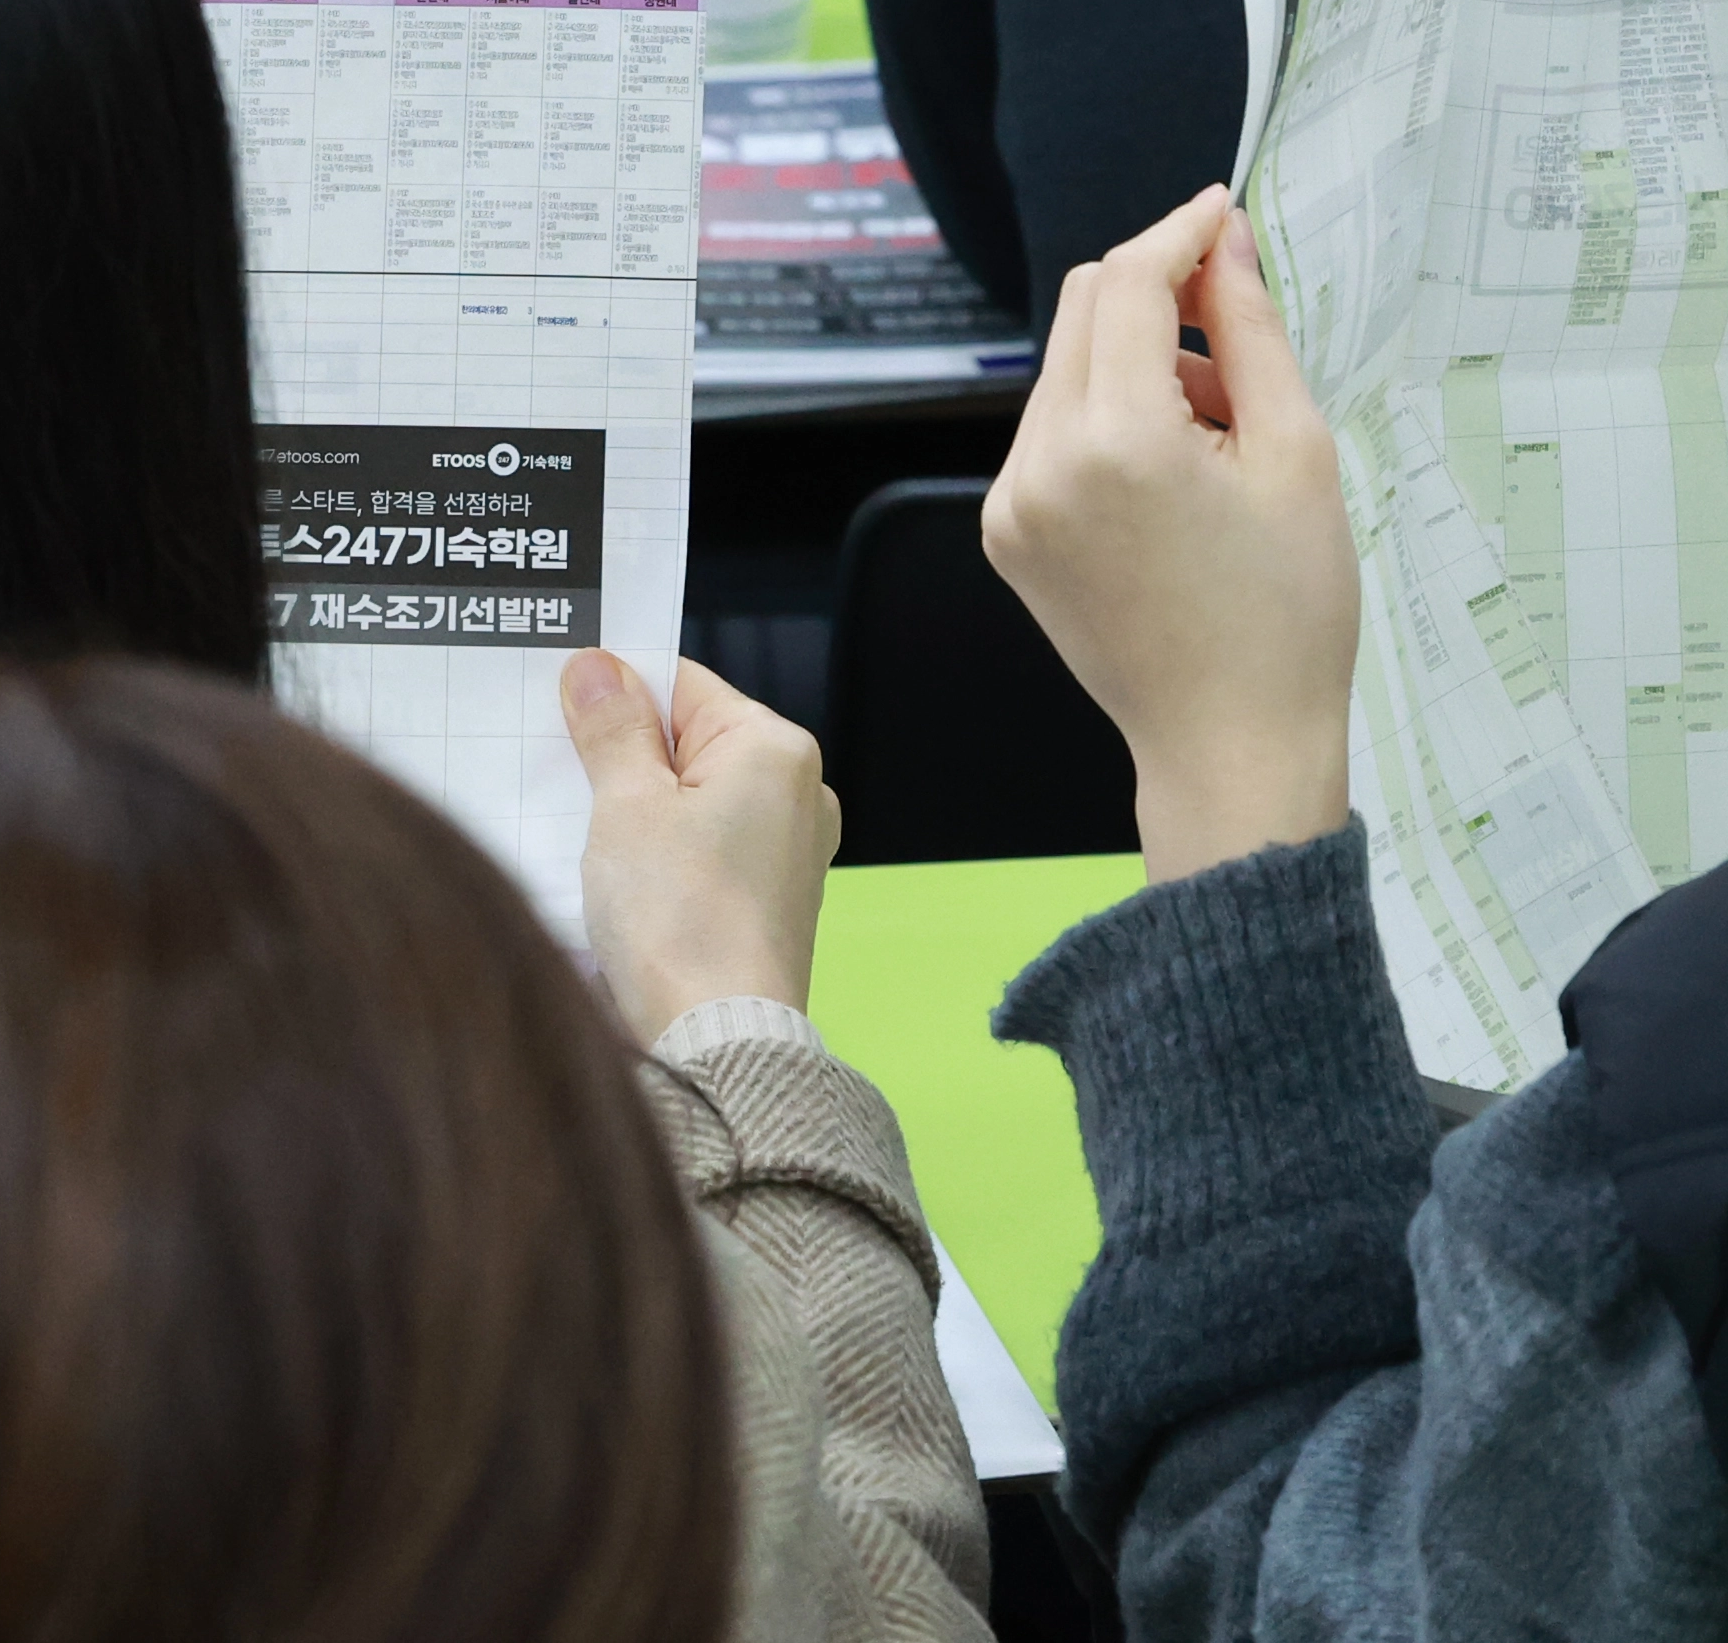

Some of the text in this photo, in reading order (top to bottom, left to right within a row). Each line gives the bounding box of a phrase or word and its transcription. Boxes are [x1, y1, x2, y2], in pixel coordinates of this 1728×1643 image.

[433, 453, 572, 471] ETOOS 247 기숙학원
[290, 489, 533, 517] 스타트, 합격을 선점하라
[309, 593, 573, 634] 재수조기선발반
